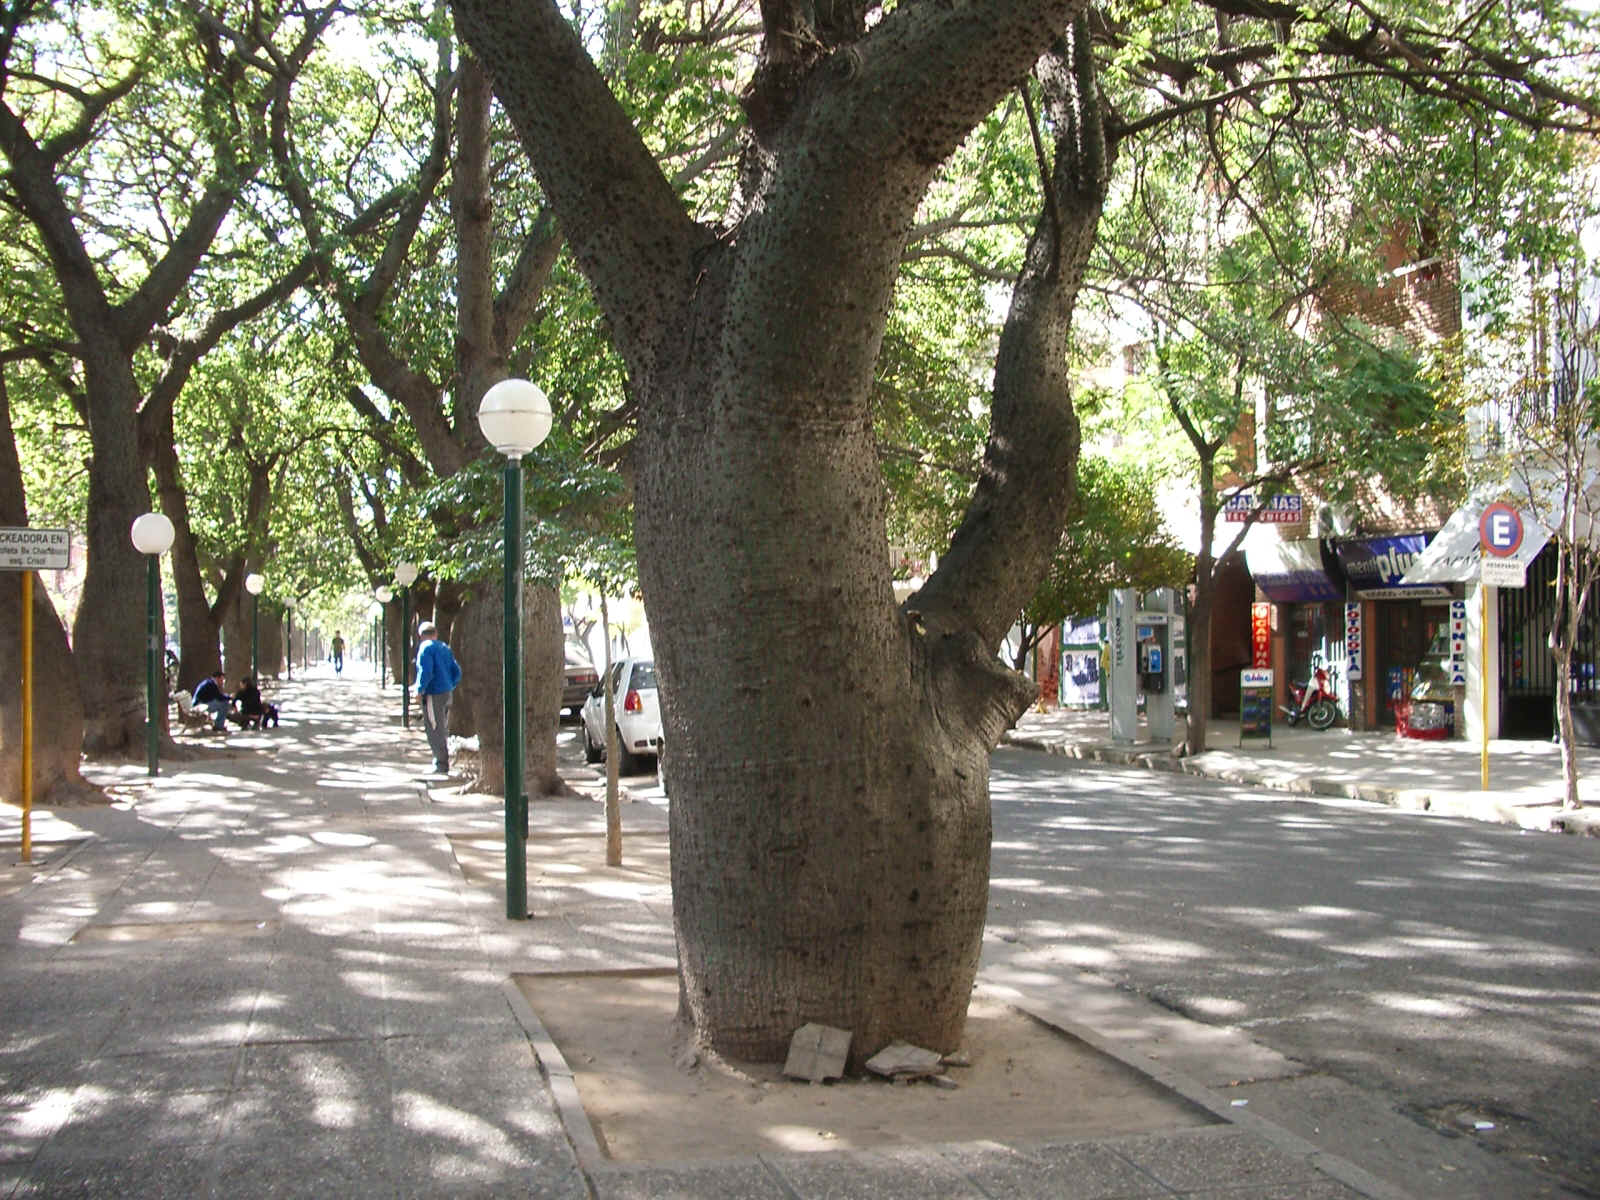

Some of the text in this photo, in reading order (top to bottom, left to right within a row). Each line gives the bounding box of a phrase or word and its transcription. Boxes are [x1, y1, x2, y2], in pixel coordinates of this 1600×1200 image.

[1493, 514, 1511, 546] E
[1347, 603, 1361, 671] FOTOCOPIA
[1452, 600, 1466, 682] QUINIELA
